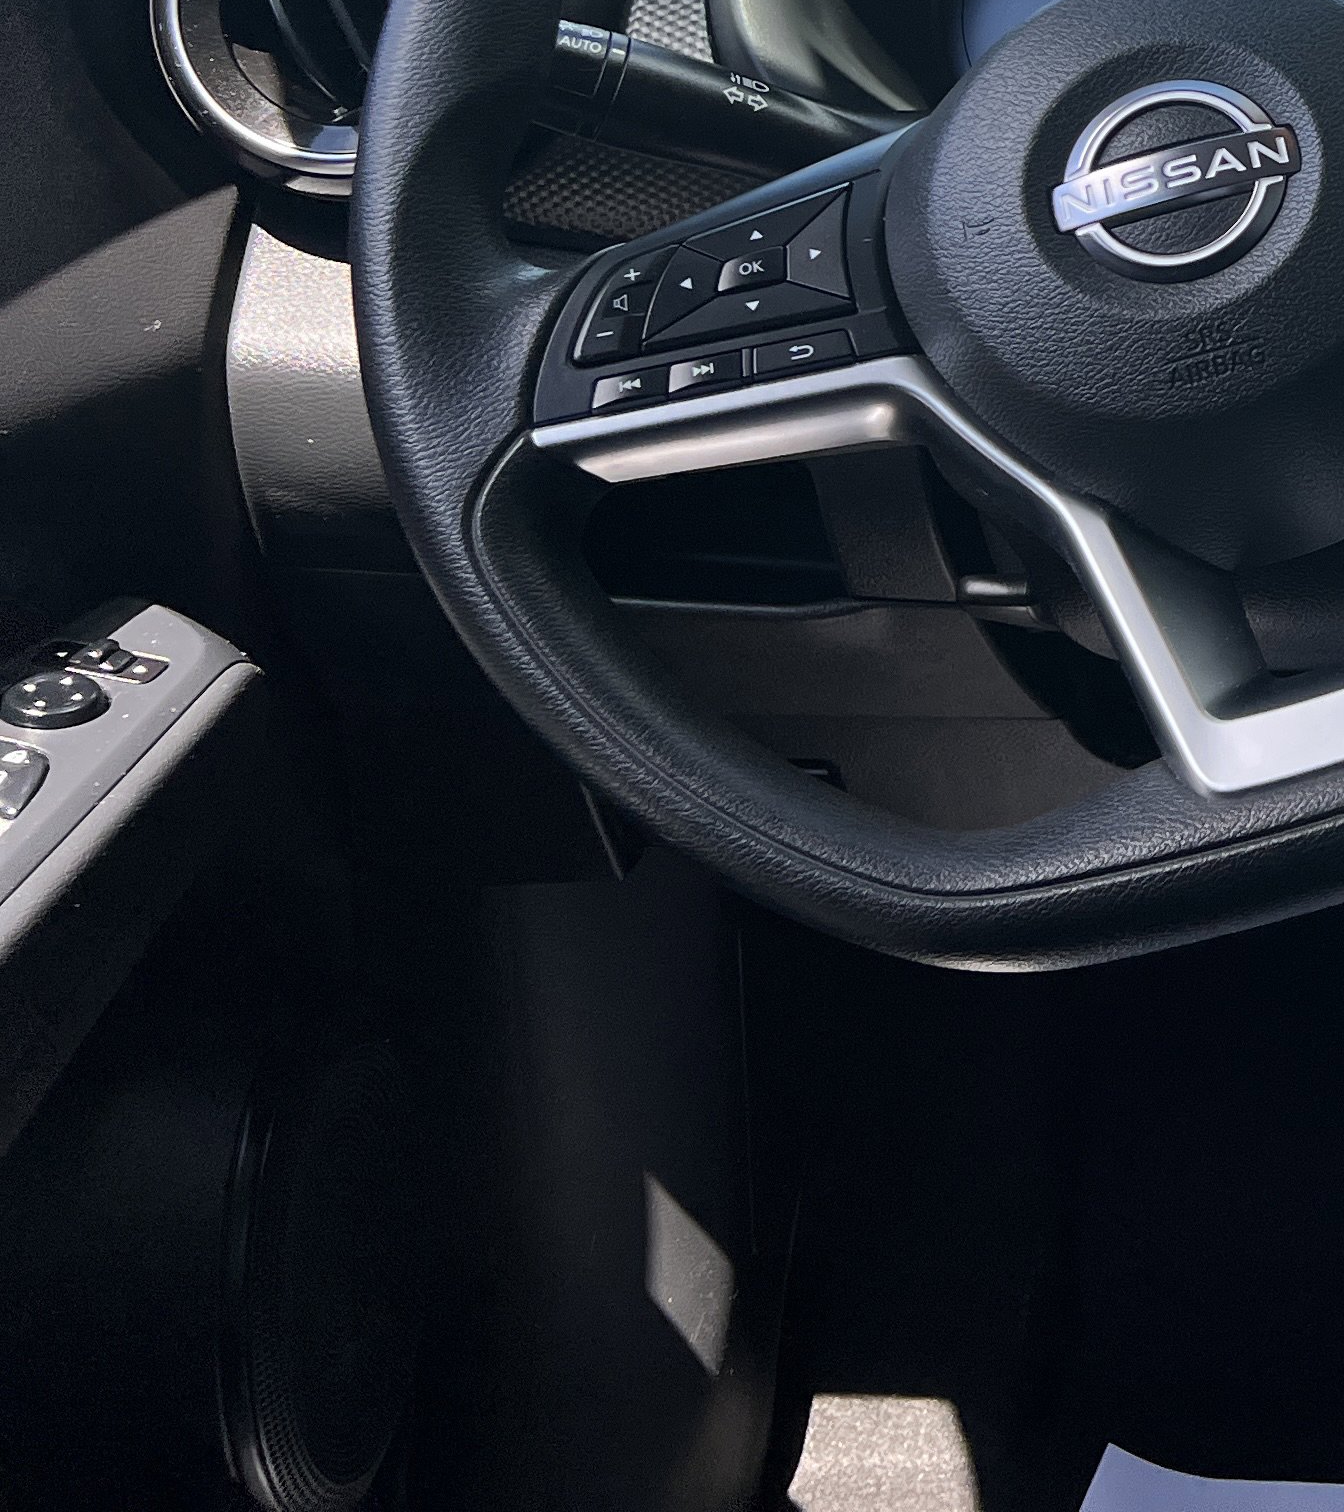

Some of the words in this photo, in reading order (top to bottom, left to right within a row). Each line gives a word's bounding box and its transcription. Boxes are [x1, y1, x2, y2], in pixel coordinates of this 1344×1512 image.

[560, 35, 602, 54] AUTO
[1058, 136, 1290, 221] NISSAN
[739, 260, 765, 275] OK
